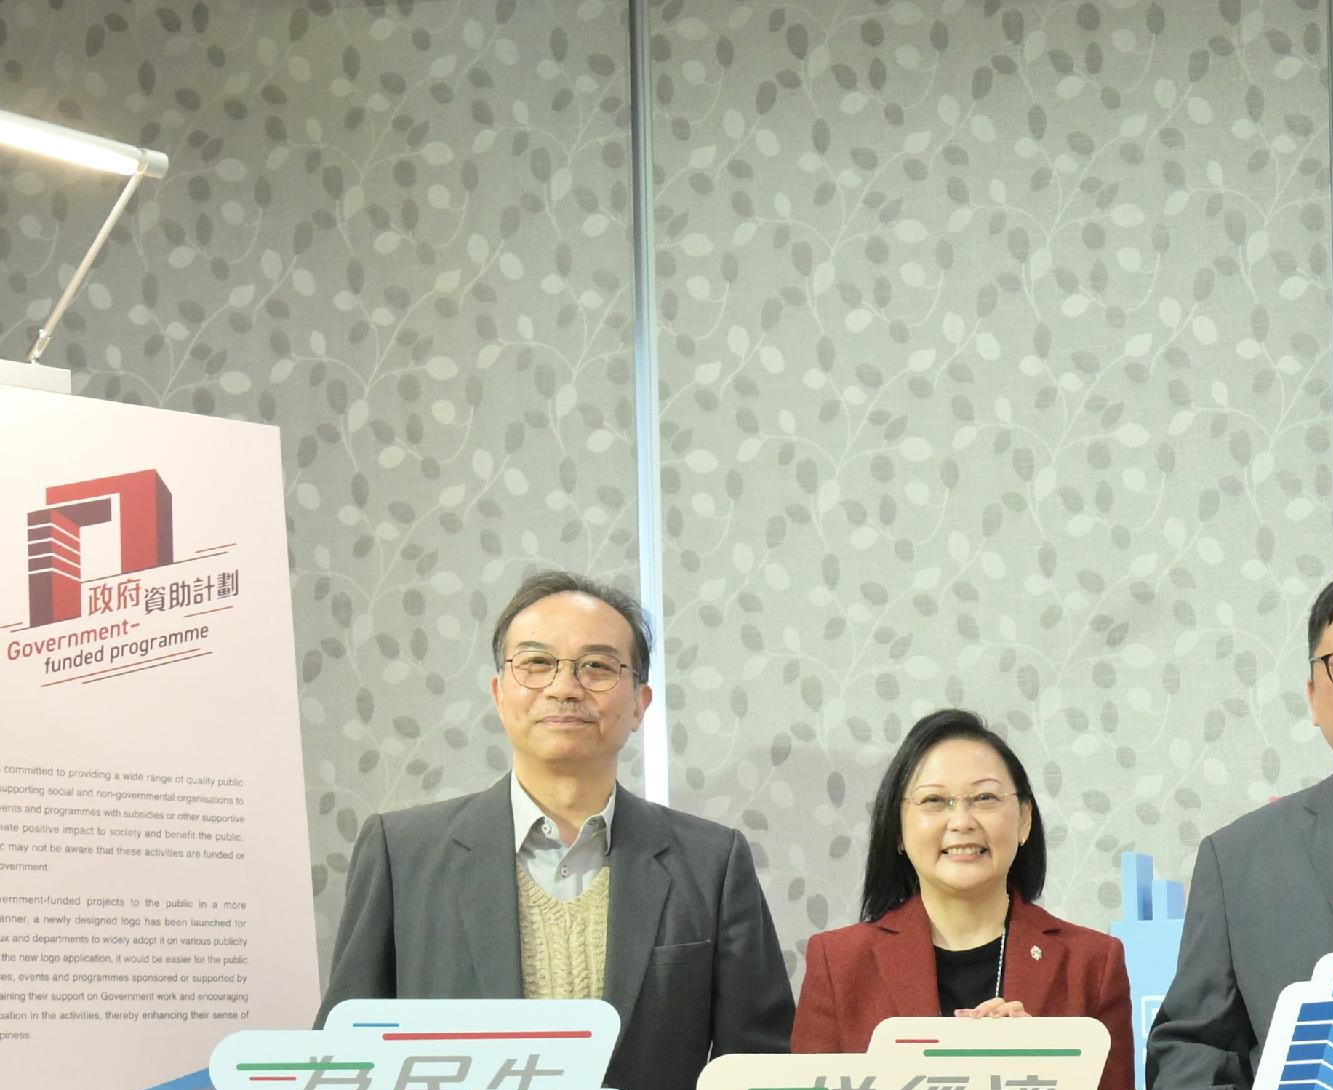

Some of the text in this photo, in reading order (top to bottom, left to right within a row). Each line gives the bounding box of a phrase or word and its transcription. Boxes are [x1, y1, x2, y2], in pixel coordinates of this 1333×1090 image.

[88, 569, 239, 616] 政府資助計劃
[7, 619, 141, 661] Government-
[44, 626, 209, 674] funded programme
[4, 765, 54, 776] committed
[68, 768, 111, 781] providing
[123, 771, 144, 781] wide
[147, 775, 172, 785] range
[186, 775, 215, 787] quality
[217, 776, 244, 789] public
[48, 786, 73, 797] social
[76, 788, 93, 797] and
[96, 789, 175, 803] non-governmental
[25, 804, 42, 814] and
[44, 807, 100, 819] programmes
[103, 808, 121, 818] with
[177, 811, 199, 821] other
[22, 823, 59, 836] positive
[62, 825, 94, 837] impact
[109, 827, 141, 839] society
[144, 829, 162, 838] and
[165, 830, 195, 840] benefit
[198, 831, 212, 841] the
[215, 832, 244, 844] public.
[8, 844, 28, 854] may
[32, 843, 47, 852] not
[65, 846, 93, 854] aware
[96, 845, 114, 855] that
[116, 846, 142, 856] these
[203, 849, 233, 859] funded
[87, 896, 125, 908] projects
[145, 898, 160, 907] the
[166, 898, 193, 910] public
[43, 914, 71, 925] newly
[75, 915, 117, 926] designed
[121, 916, 141, 927] logo
[144, 916, 161, 925] has
[164, 916, 187, 926] been
[191, 917, 232, 927] launched
[234, 918, 247, 927] for
[12, 933, 30, 943] and
[32, 934, 89, 946] departments
[102, 935, 130, 946] widely
[133, 935, 157, 947] adopt
[213, 937, 248, 948] publicity
[1, 952, 16, 961] the
[40, 952, 60, 964] logo
[63, 953, 113, 964] application,
[124, 953, 149, 962] would
[165, 954, 192, 963] easier
[194, 954, 205, 963] for
[207, 954, 221, 963] the
[223, 954, 248, 965] public
[18, 973, 50, 981] events
[52, 972, 69, 981] and
[72, 975, 129, 984] programmes
[132, 973, 178, 984] sponsored
[192, 973, 234, 985] supported
[28, 991, 48, 1000] their
[51, 992, 84, 1002] support
[101, 992, 154, 1001] Government
[157, 992, 177, 1001] work
[180, 992, 195, 1001] and
[198, 992, 249, 1003] encouraging
[41, 1010, 56, 1019] the
[59, 1010, 102, 1020] activities,
[105, 1010, 139, 1021] thereby
[142, 1010, 188, 1021] enhancing
[190, 1010, 210, 1019] their
